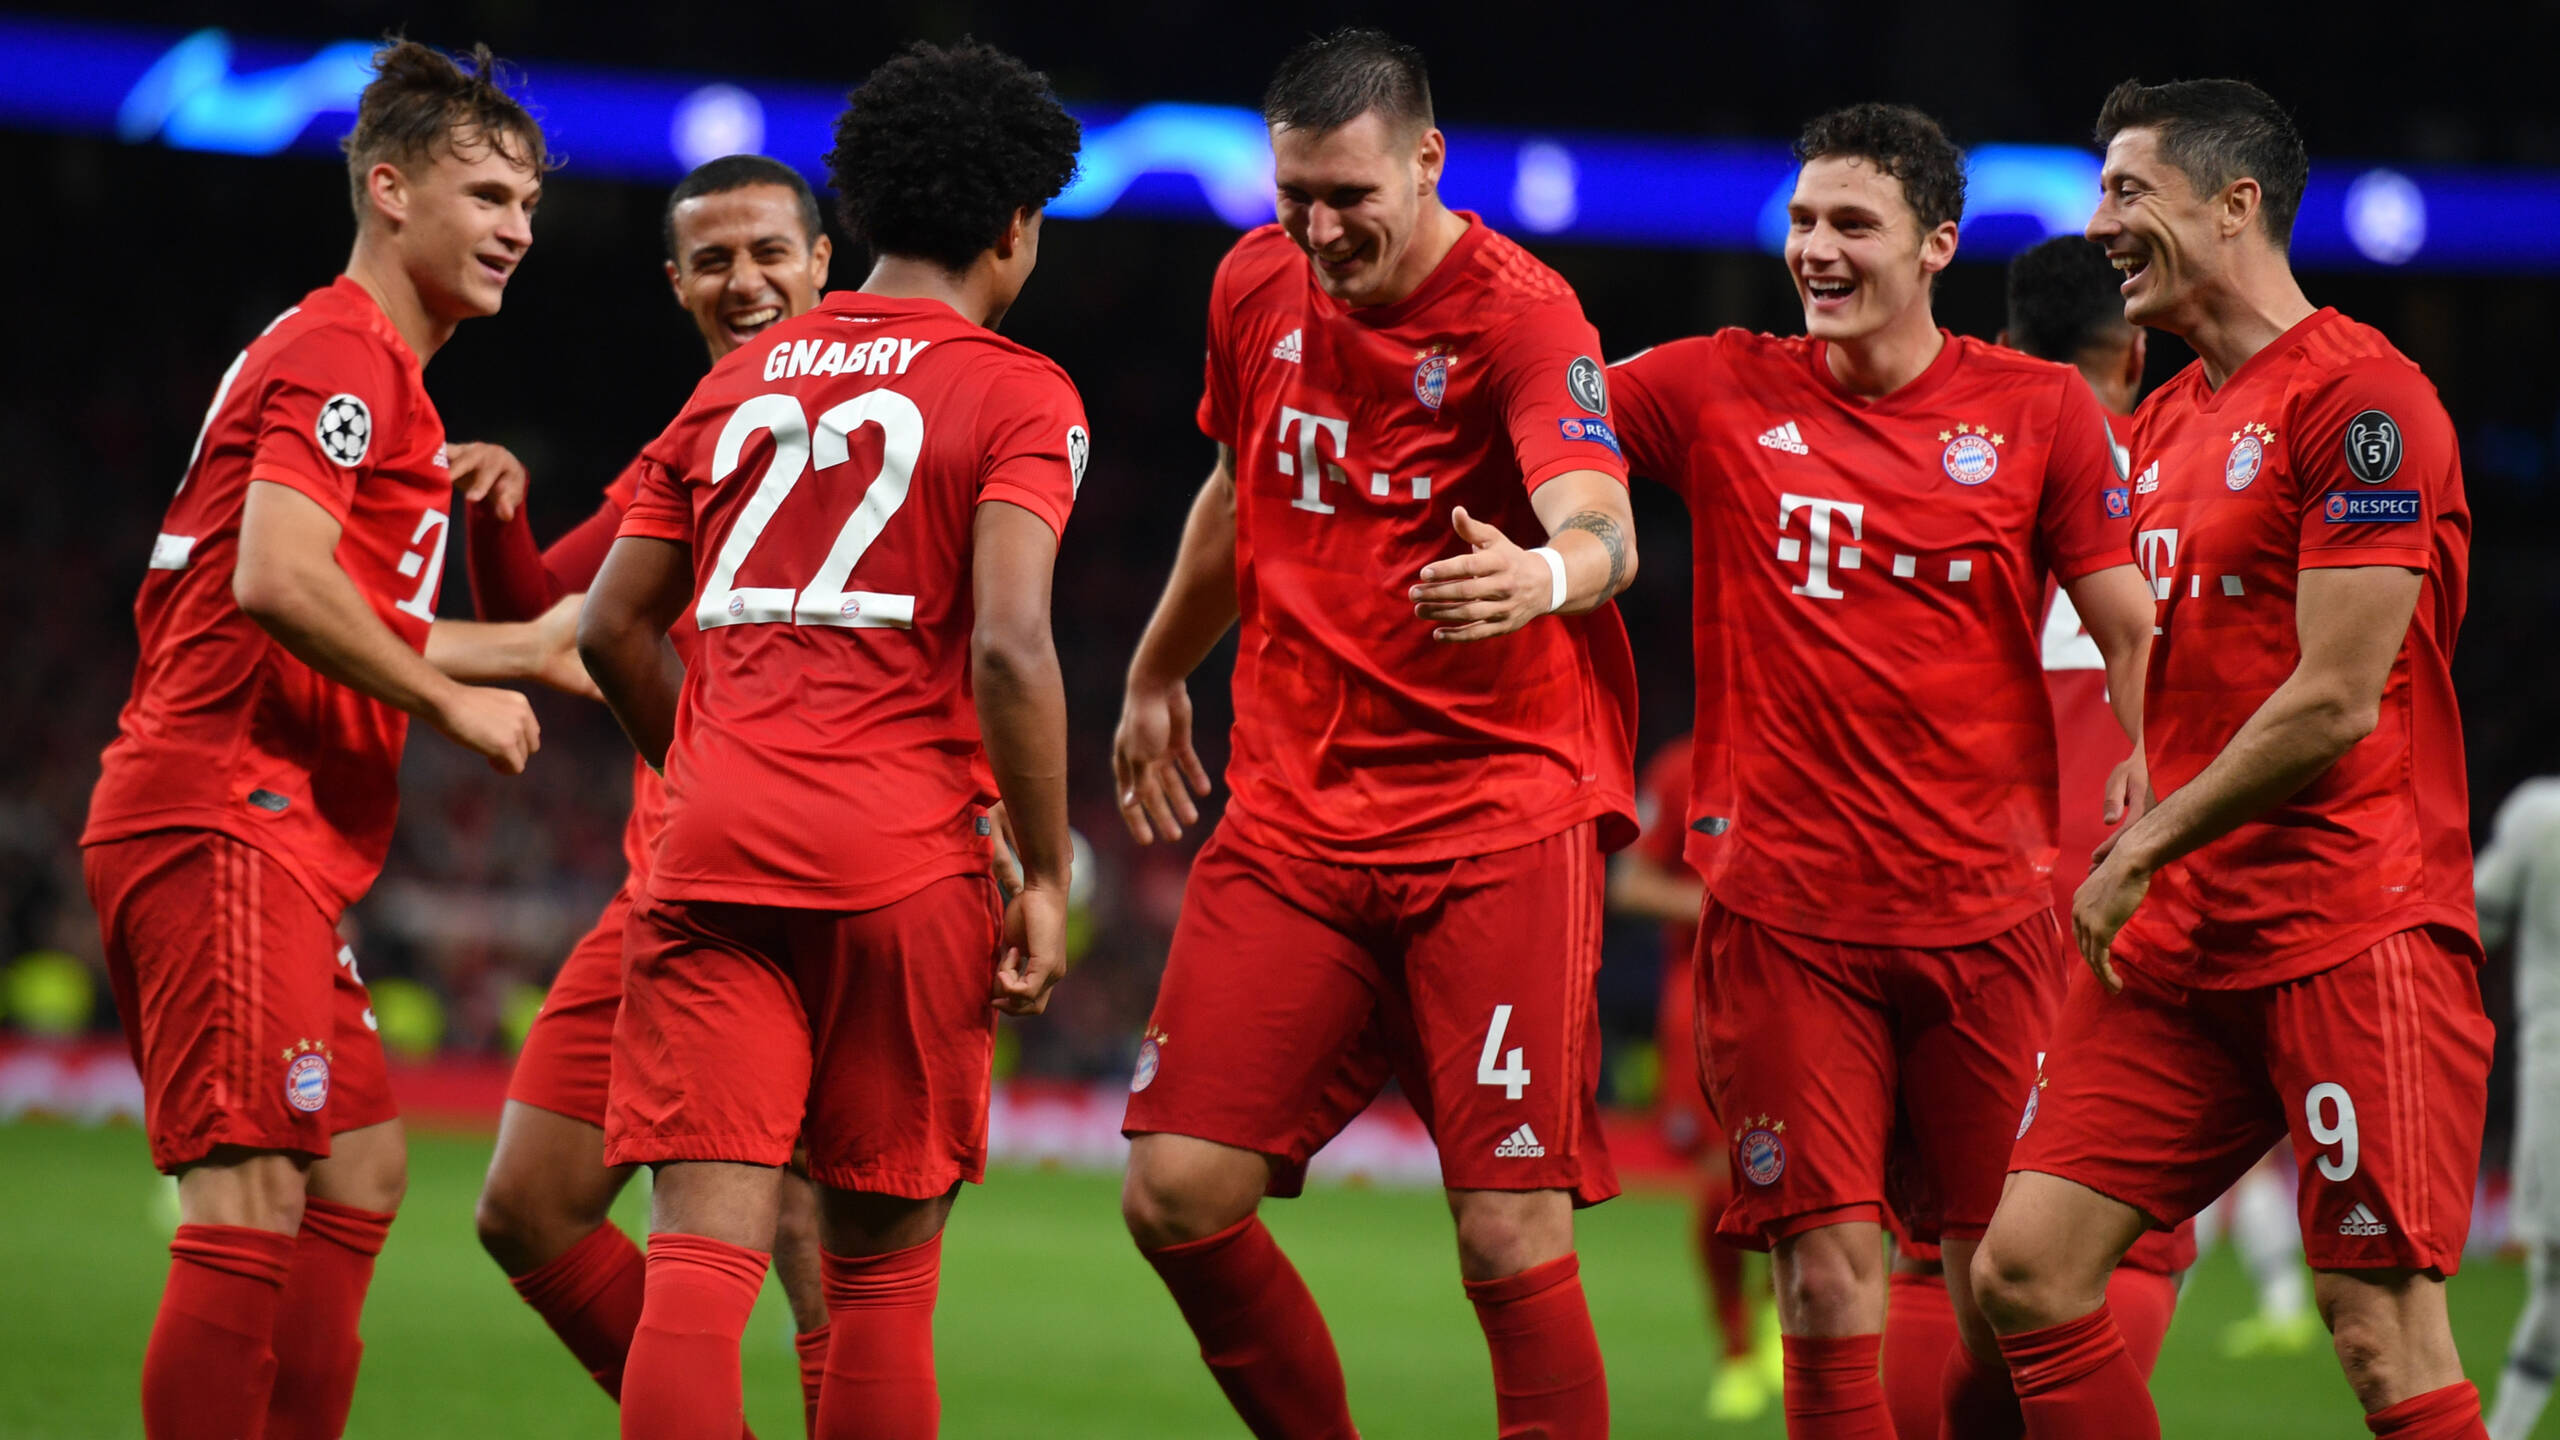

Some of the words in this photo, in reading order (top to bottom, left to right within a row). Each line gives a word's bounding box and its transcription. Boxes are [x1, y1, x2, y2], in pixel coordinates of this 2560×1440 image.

[763, 336, 931, 381] GNABRY
[1273, 347, 1302, 363] adida
[1758, 433, 1809, 455] adidas
[2368, 445, 2381, 464] 5
[696, 387, 925, 631] 22
[2349, 500, 2420, 514] RESPECT
[1477, 1004, 1531, 1100] 4
[2305, 1082, 2359, 1182] 9
[1494, 1143, 1545, 1158] adidas
[2339, 1223, 2388, 1236] adidas
